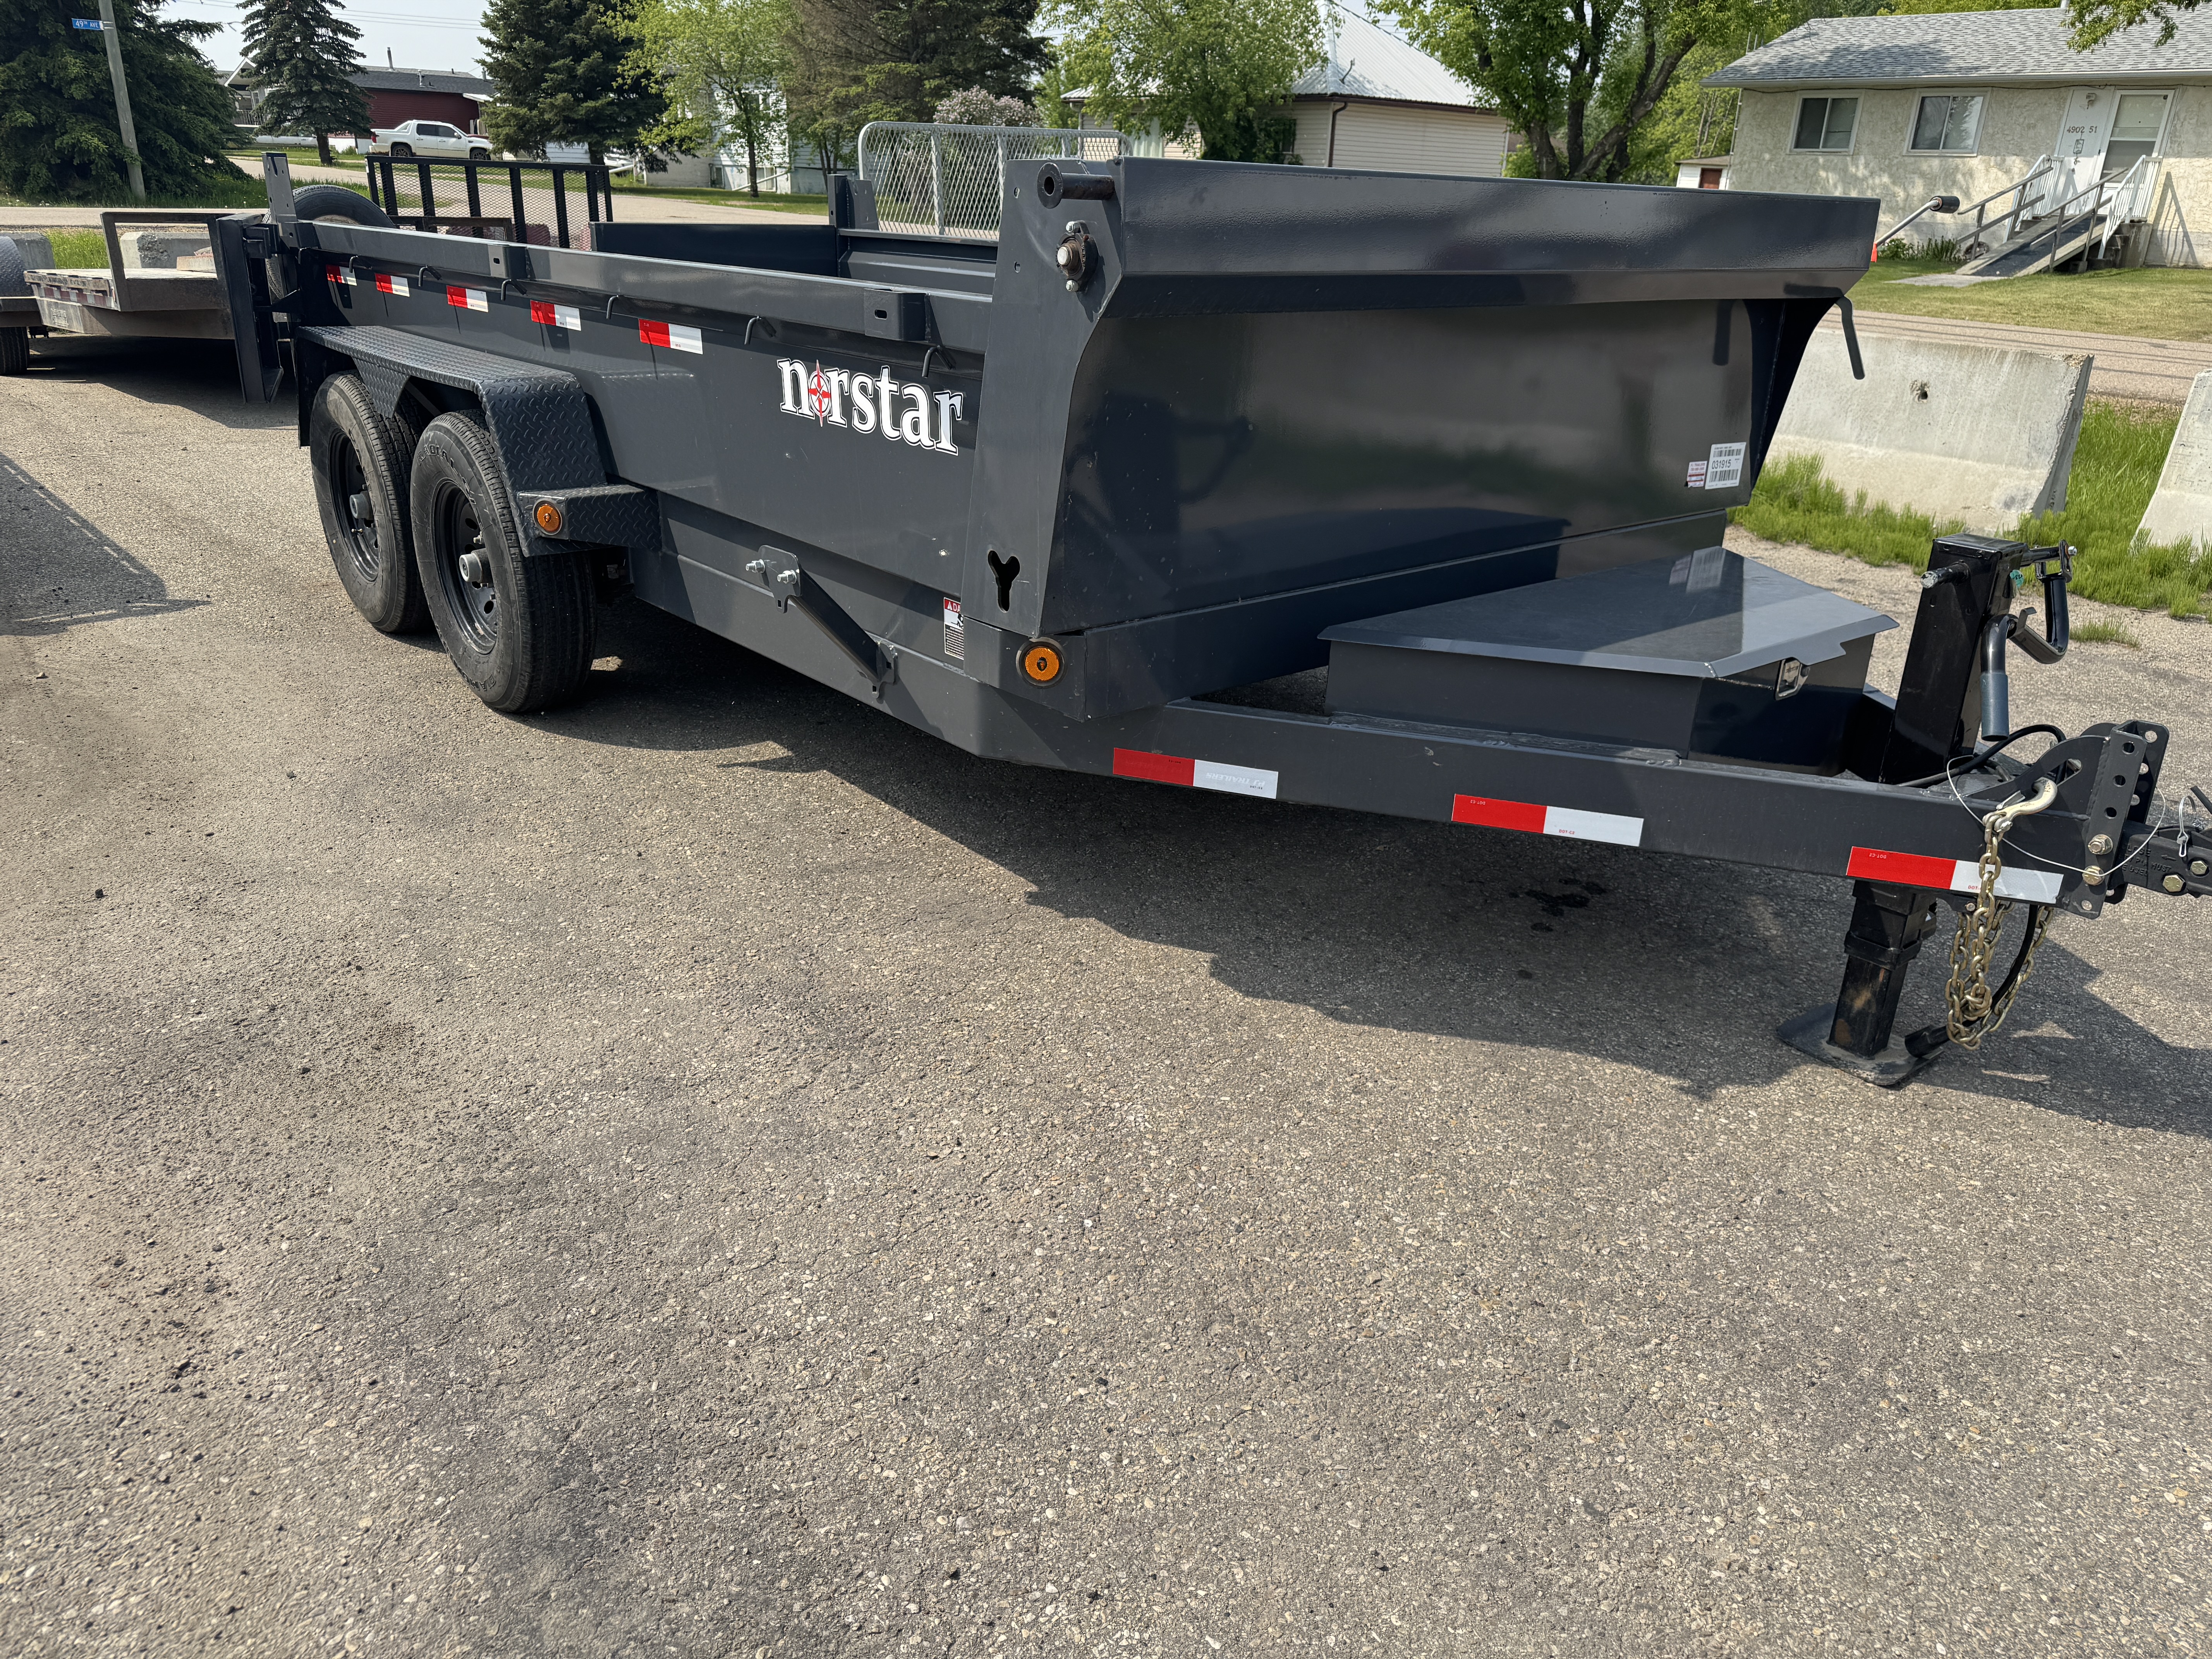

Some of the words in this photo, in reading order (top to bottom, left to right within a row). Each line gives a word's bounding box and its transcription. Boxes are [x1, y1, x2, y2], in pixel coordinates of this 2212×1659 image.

[777, 358, 963, 456] norstar
[1712, 459, 1731, 469] 031915
[2152, 862, 2172, 872] MUST
